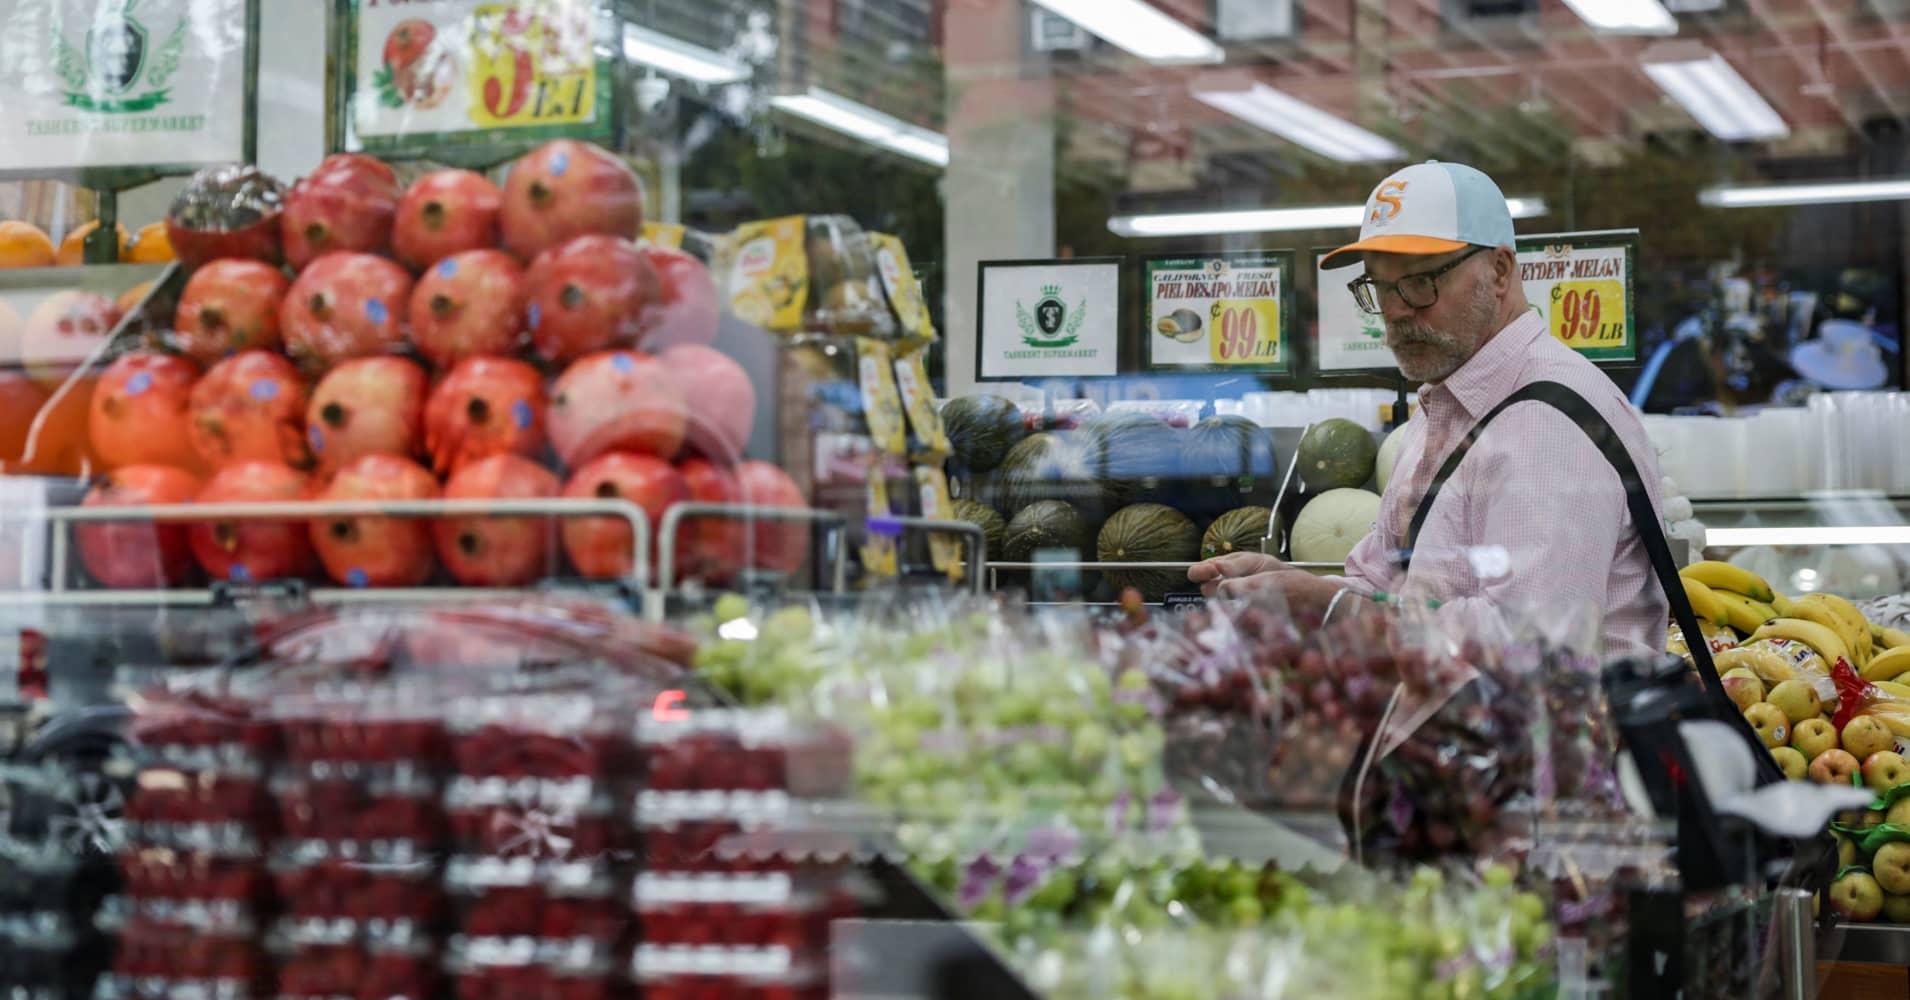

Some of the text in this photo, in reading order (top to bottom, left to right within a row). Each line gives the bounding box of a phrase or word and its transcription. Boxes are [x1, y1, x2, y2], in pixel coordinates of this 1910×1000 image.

[1370, 179, 1408, 227] S
[1520, 258, 1622, 281] EYDEW MELON
[1232, 278, 1278, 297] MELON
[1560, 288, 1601, 340] 99
[1599, 323, 1624, 340] LB
[1219, 307, 1257, 360] 99
[1255, 340, 1278, 357] LB
[1003, 348, 1098, 360] TASHKENT SUPERMARKET
[1342, 342, 1385, 351] TASHKEN
